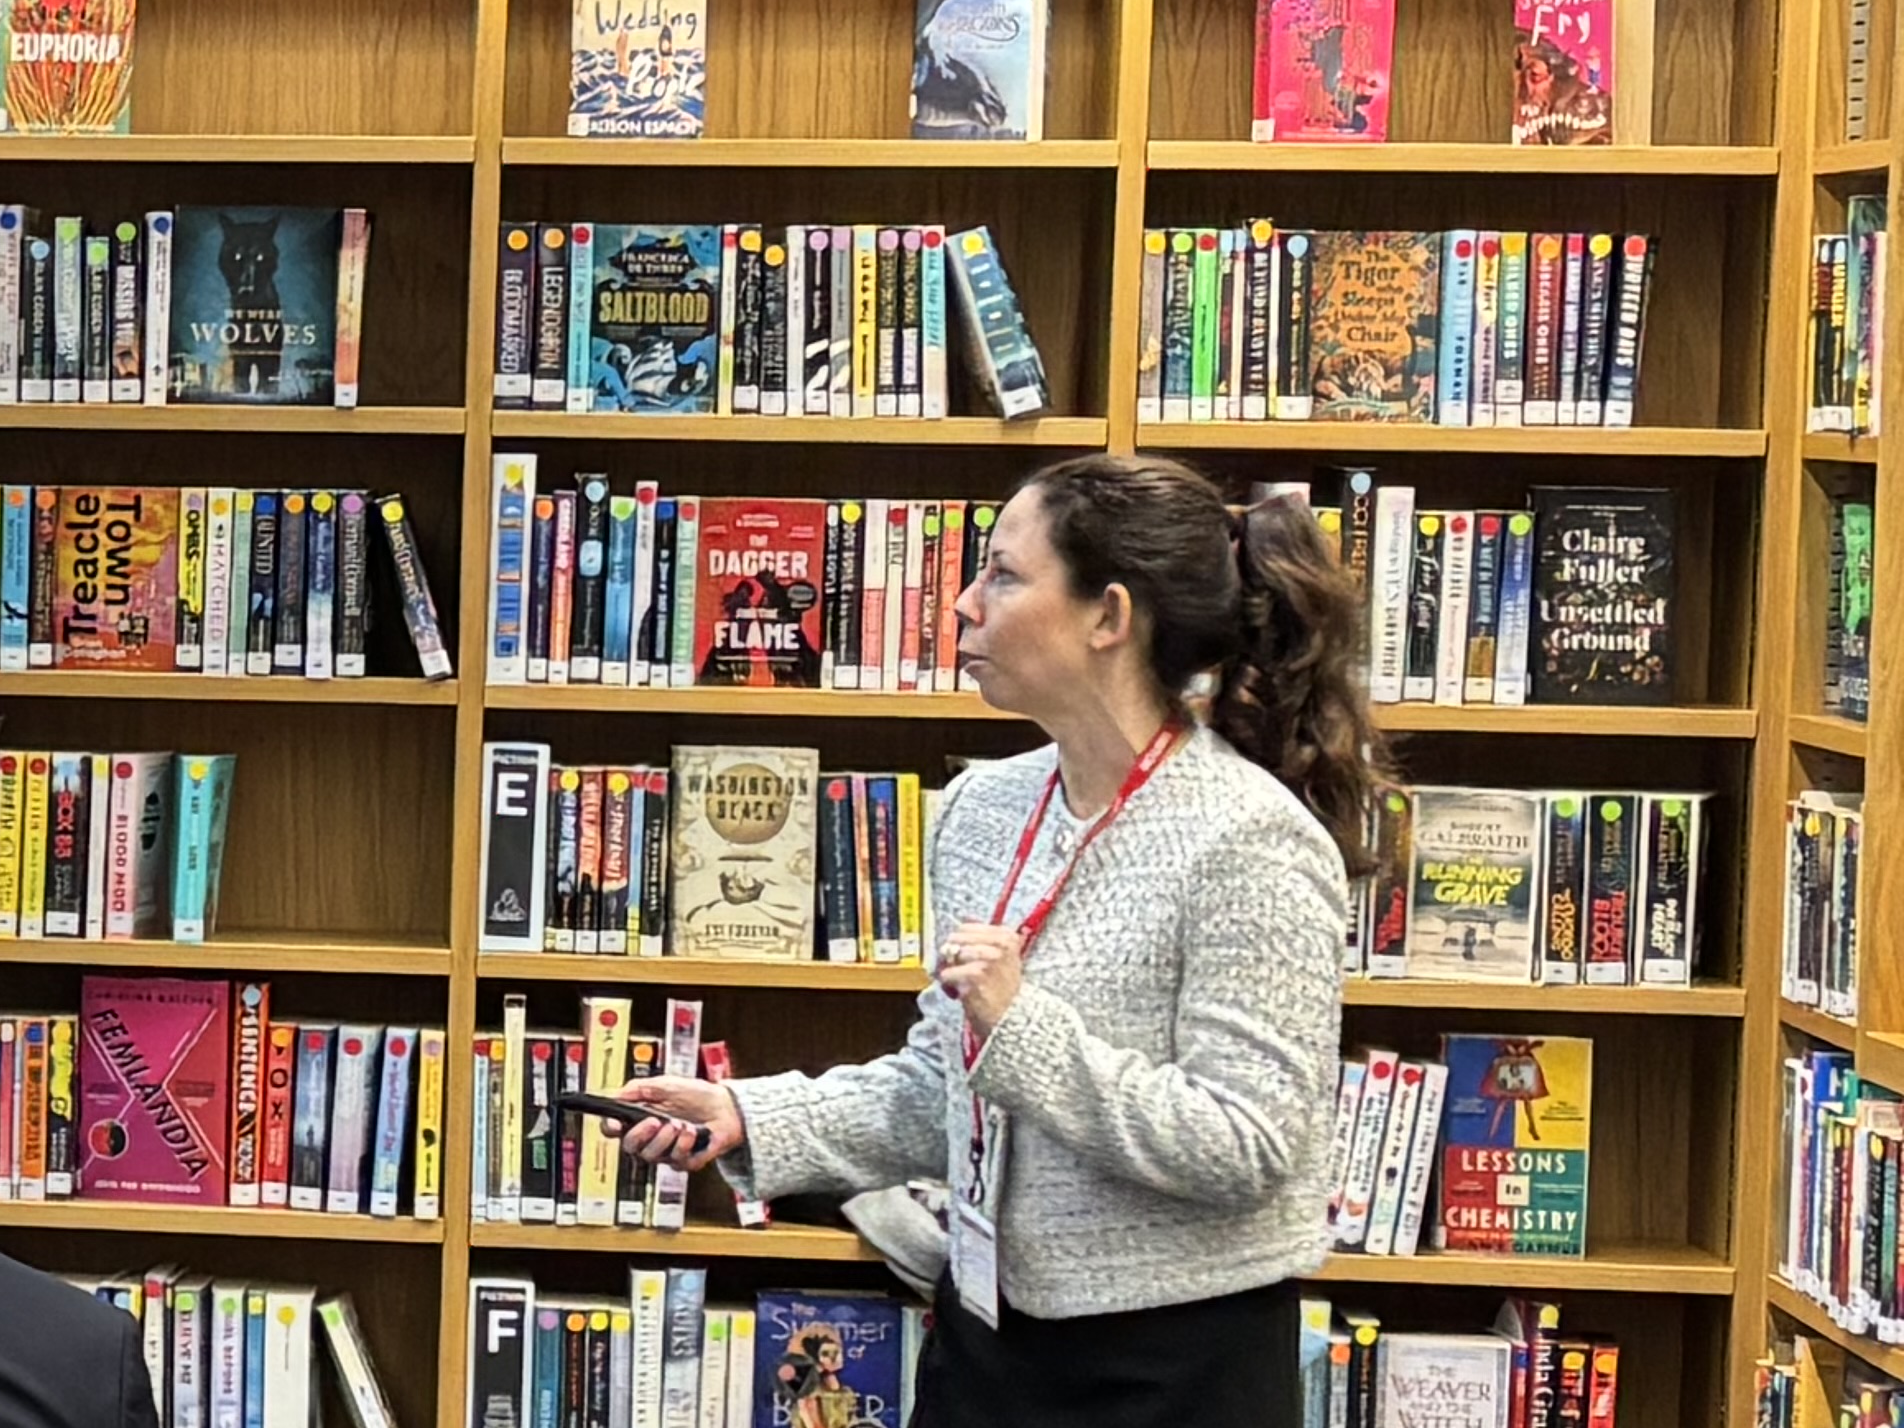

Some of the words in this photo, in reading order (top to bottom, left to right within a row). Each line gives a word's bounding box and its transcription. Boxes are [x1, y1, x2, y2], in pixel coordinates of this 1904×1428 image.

[594, 0, 699, 42] Wedding
[1530, 4, 1592, 48] Fry
[10, 32, 122, 63] EUPHORIA
[598, 290, 710, 324] SALTBLOOD
[189, 321, 317, 346] WOLVES
[105, 493, 142, 607] Town
[1561, 528, 1646, 554] Claire
[62, 493, 101, 645] Treacle
[708, 550, 809, 578] DAGGER
[1561, 557, 1646, 584] Fuller
[1539, 597, 1668, 625] Unsettled
[713, 622, 801, 650] FLAME
[1550, 627, 1652, 653] Ground
[496, 772, 530, 817] E
[716, 799, 779, 824] BLACK
[1422, 861, 1525, 885] RUNNING
[1434, 881, 1511, 906] GRAVE
[90, 1008, 211, 1181] FEMLANDIA
[1461, 1151, 1567, 1175] LESSONS
[1505, 1185, 1523, 1197] In
[1445, 1207, 1578, 1232] CHEMISTRY
[487, 1309, 519, 1353] F
[1533, 1324, 1556, 1383] inda
[1390, 1373, 1491, 1404] WEAVER
